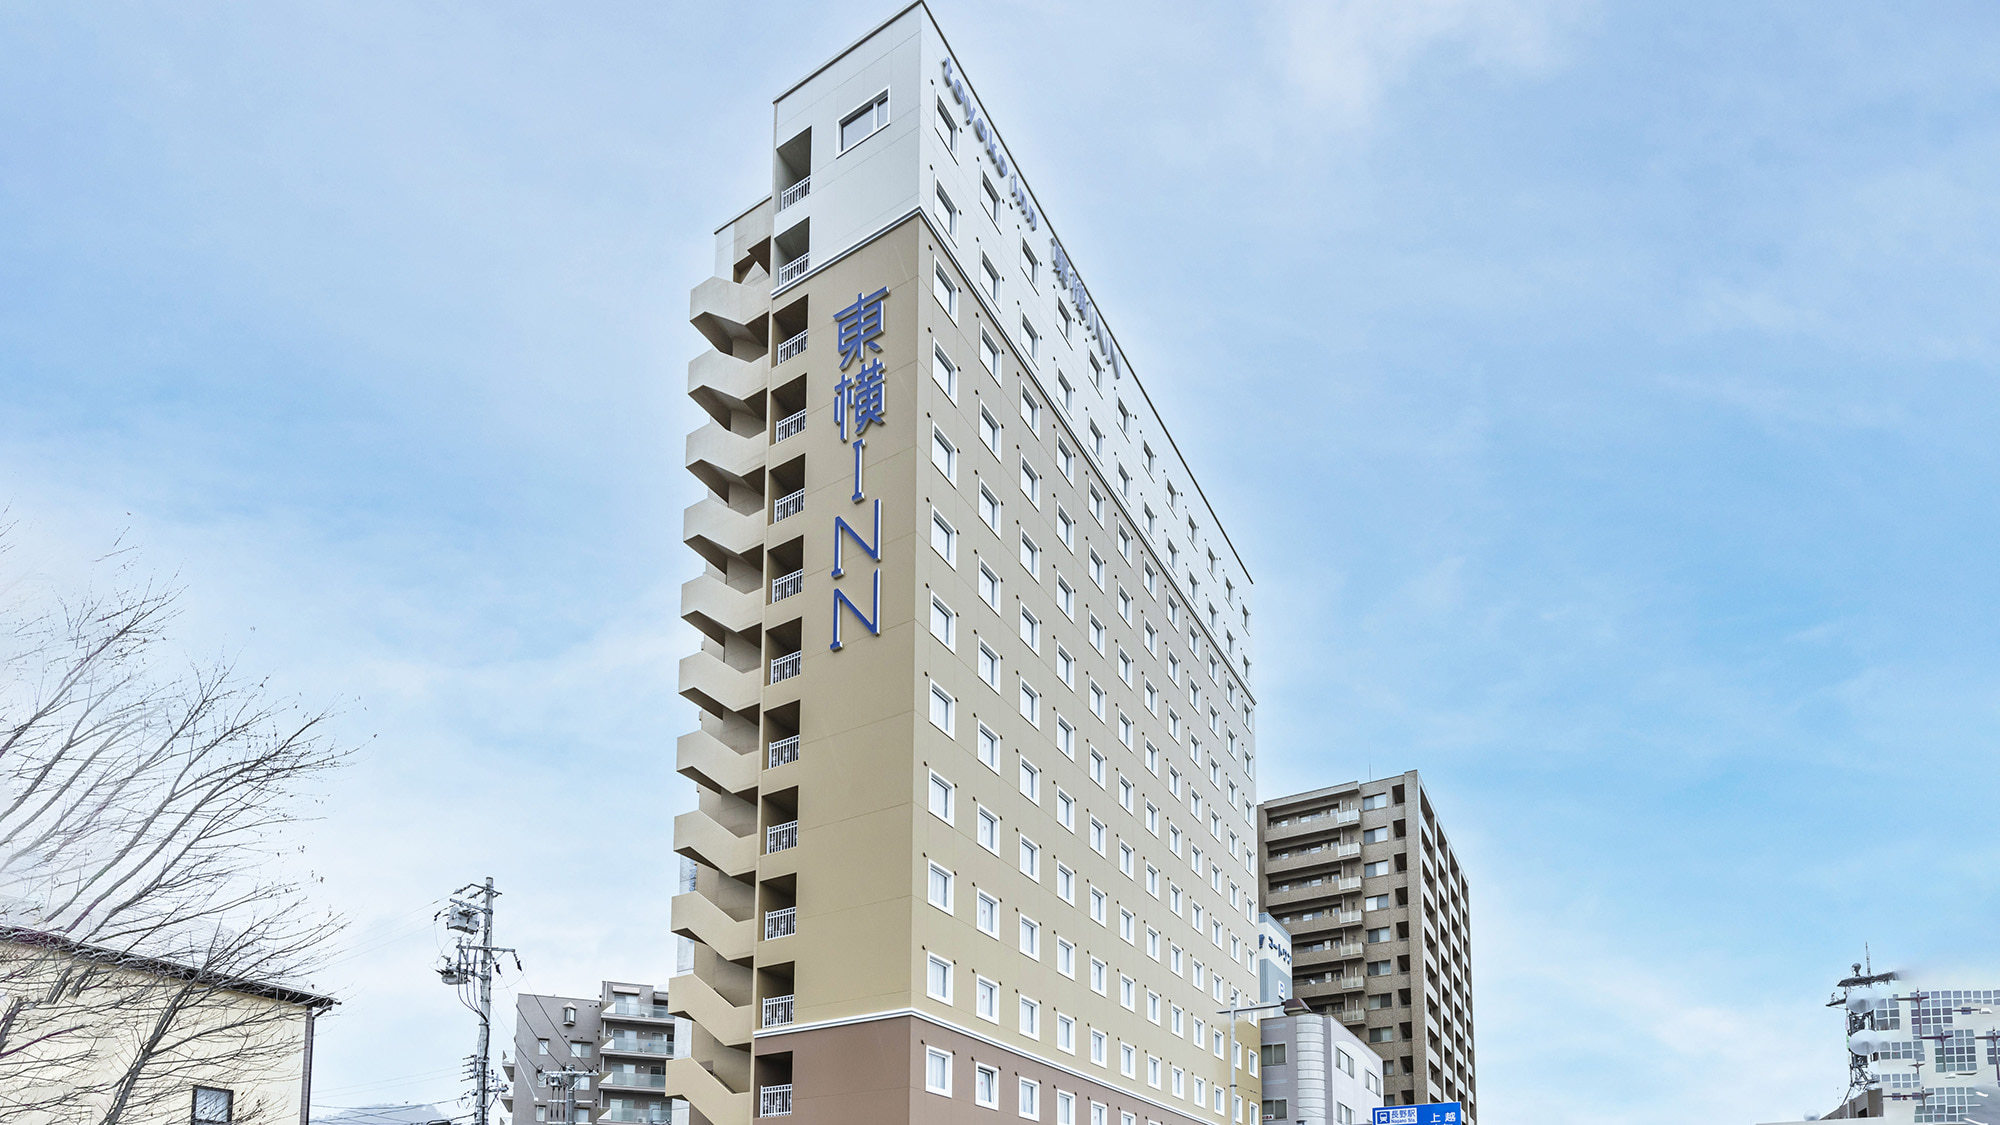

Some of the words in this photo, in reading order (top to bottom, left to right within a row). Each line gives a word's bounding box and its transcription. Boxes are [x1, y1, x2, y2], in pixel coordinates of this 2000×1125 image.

[942, 57, 1008, 178] toyoko
[1010, 171, 1037, 232] inn
[830, 286, 890, 650] 東横INN
[1391, 1109, 1416, 1119] 長野駅
